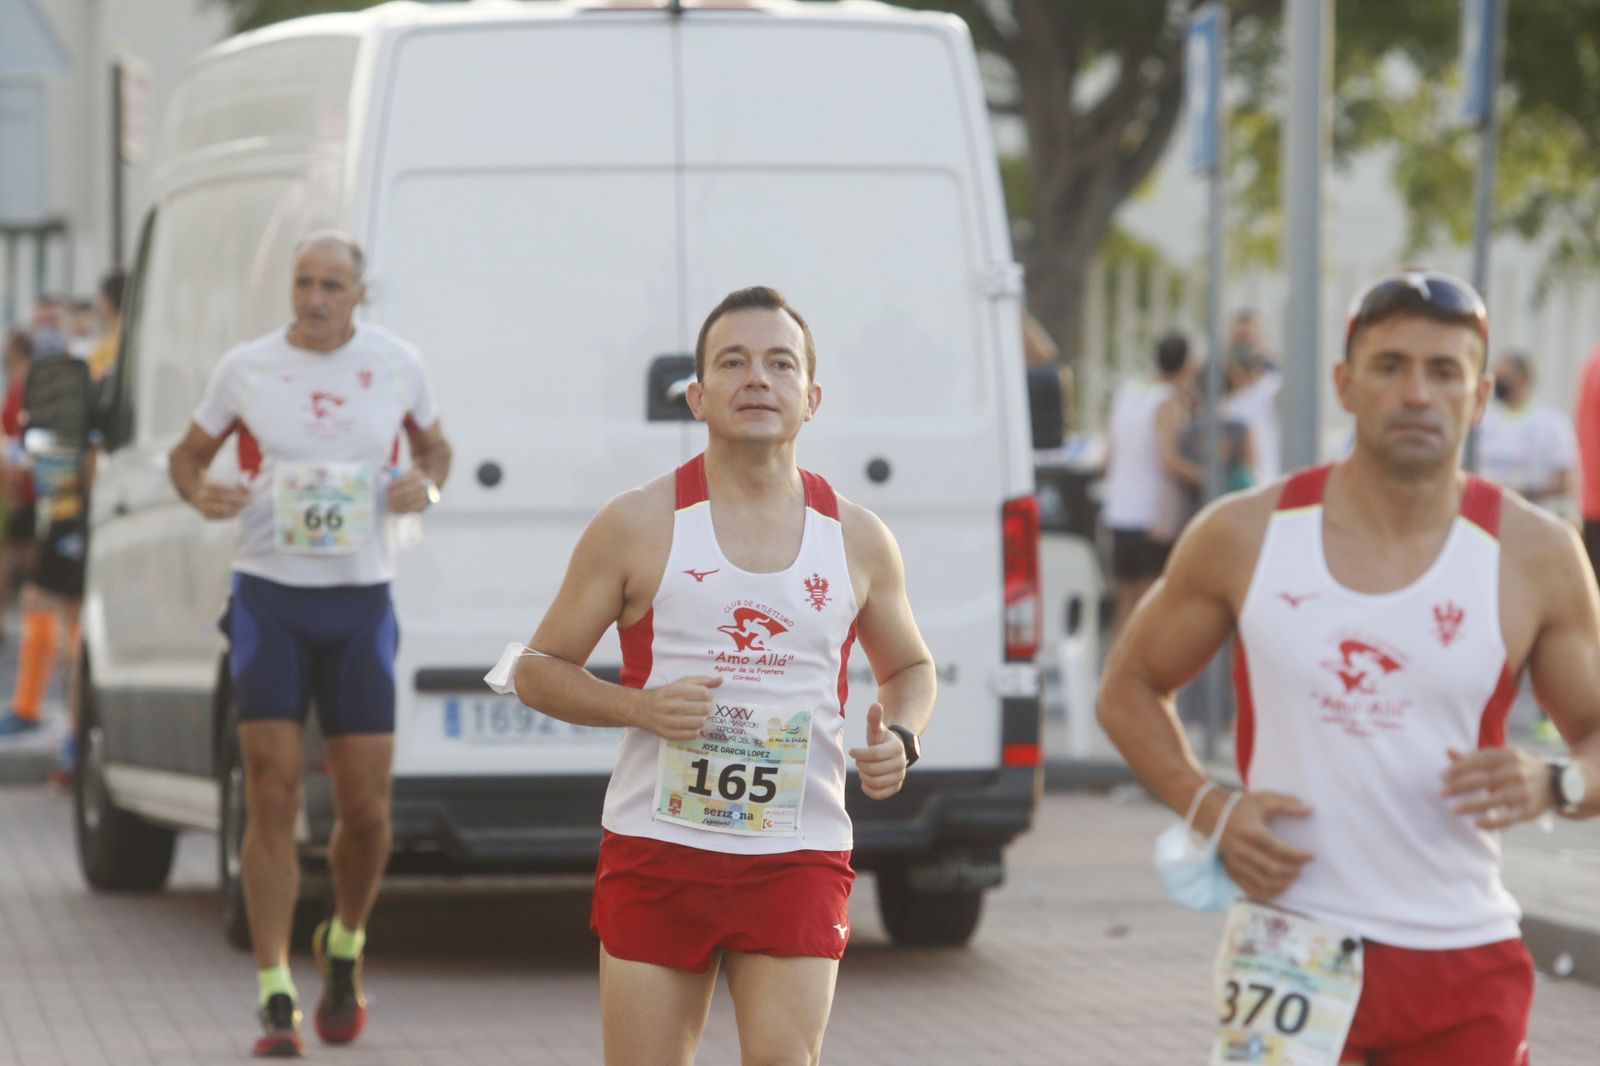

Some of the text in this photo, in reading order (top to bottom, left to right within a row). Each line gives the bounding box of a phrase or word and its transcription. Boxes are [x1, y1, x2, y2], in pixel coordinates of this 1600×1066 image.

[304, 504, 343, 531] 66
[724, 600, 741, 614] CLUB
[755, 603, 795, 628] ATLETISMO
[713, 665, 737, 673] Aguilar
[757, 667, 785, 675] Frontera
[714, 704, 754, 721] XXXV
[702, 743, 771, 759] JOSE GARCIA LOPEZ
[688, 758, 779, 803] 165
[1220, 981, 1311, 1035] 370
